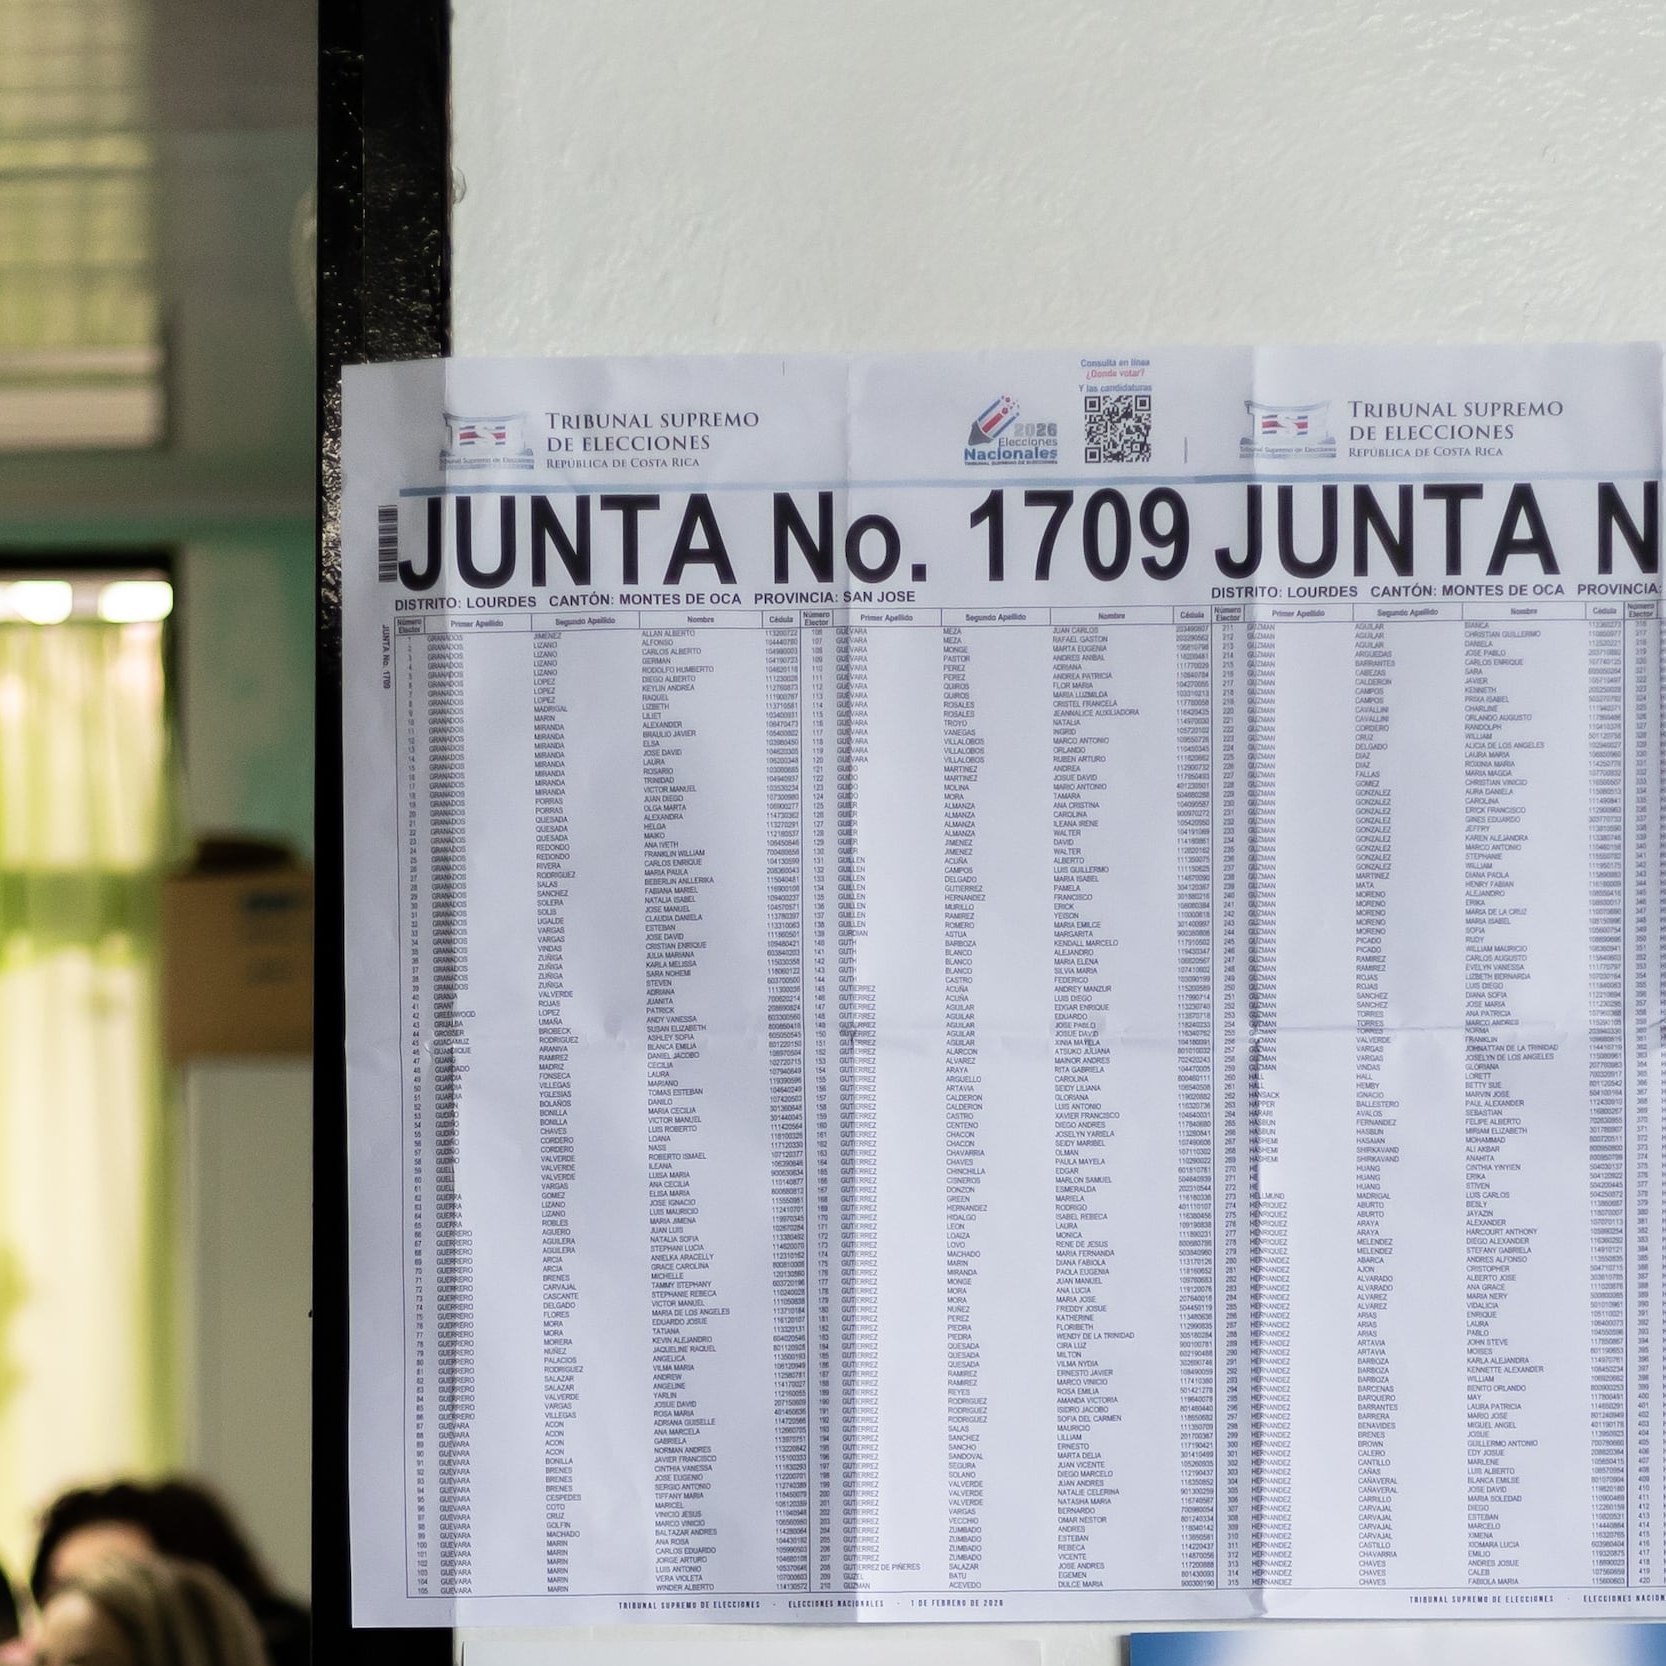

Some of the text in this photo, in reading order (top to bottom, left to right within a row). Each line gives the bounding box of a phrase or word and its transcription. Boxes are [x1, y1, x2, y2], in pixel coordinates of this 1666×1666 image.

[1348, 401, 1563, 418] TRIBUNAL SUPREMO
[546, 412, 758, 429] TRIBUNAL SUPREMO
[1014, 423, 1057, 437] 2026
[1351, 425, 1513, 440] DE ELECCIONES
[548, 435, 709, 451] DE ELECCIONES
[999, 438, 1057, 447] Elecciones
[964, 447, 1057, 460] Nacionales
[1215, 482, 1560, 579] JUNTA
[398, 487, 1189, 592] JUNTA No. 1709
[395, 591, 915, 611] DISTRITO: LOURDES CANTÓN: MONTES DE OCA PROVINCIA: SAN JOSE
